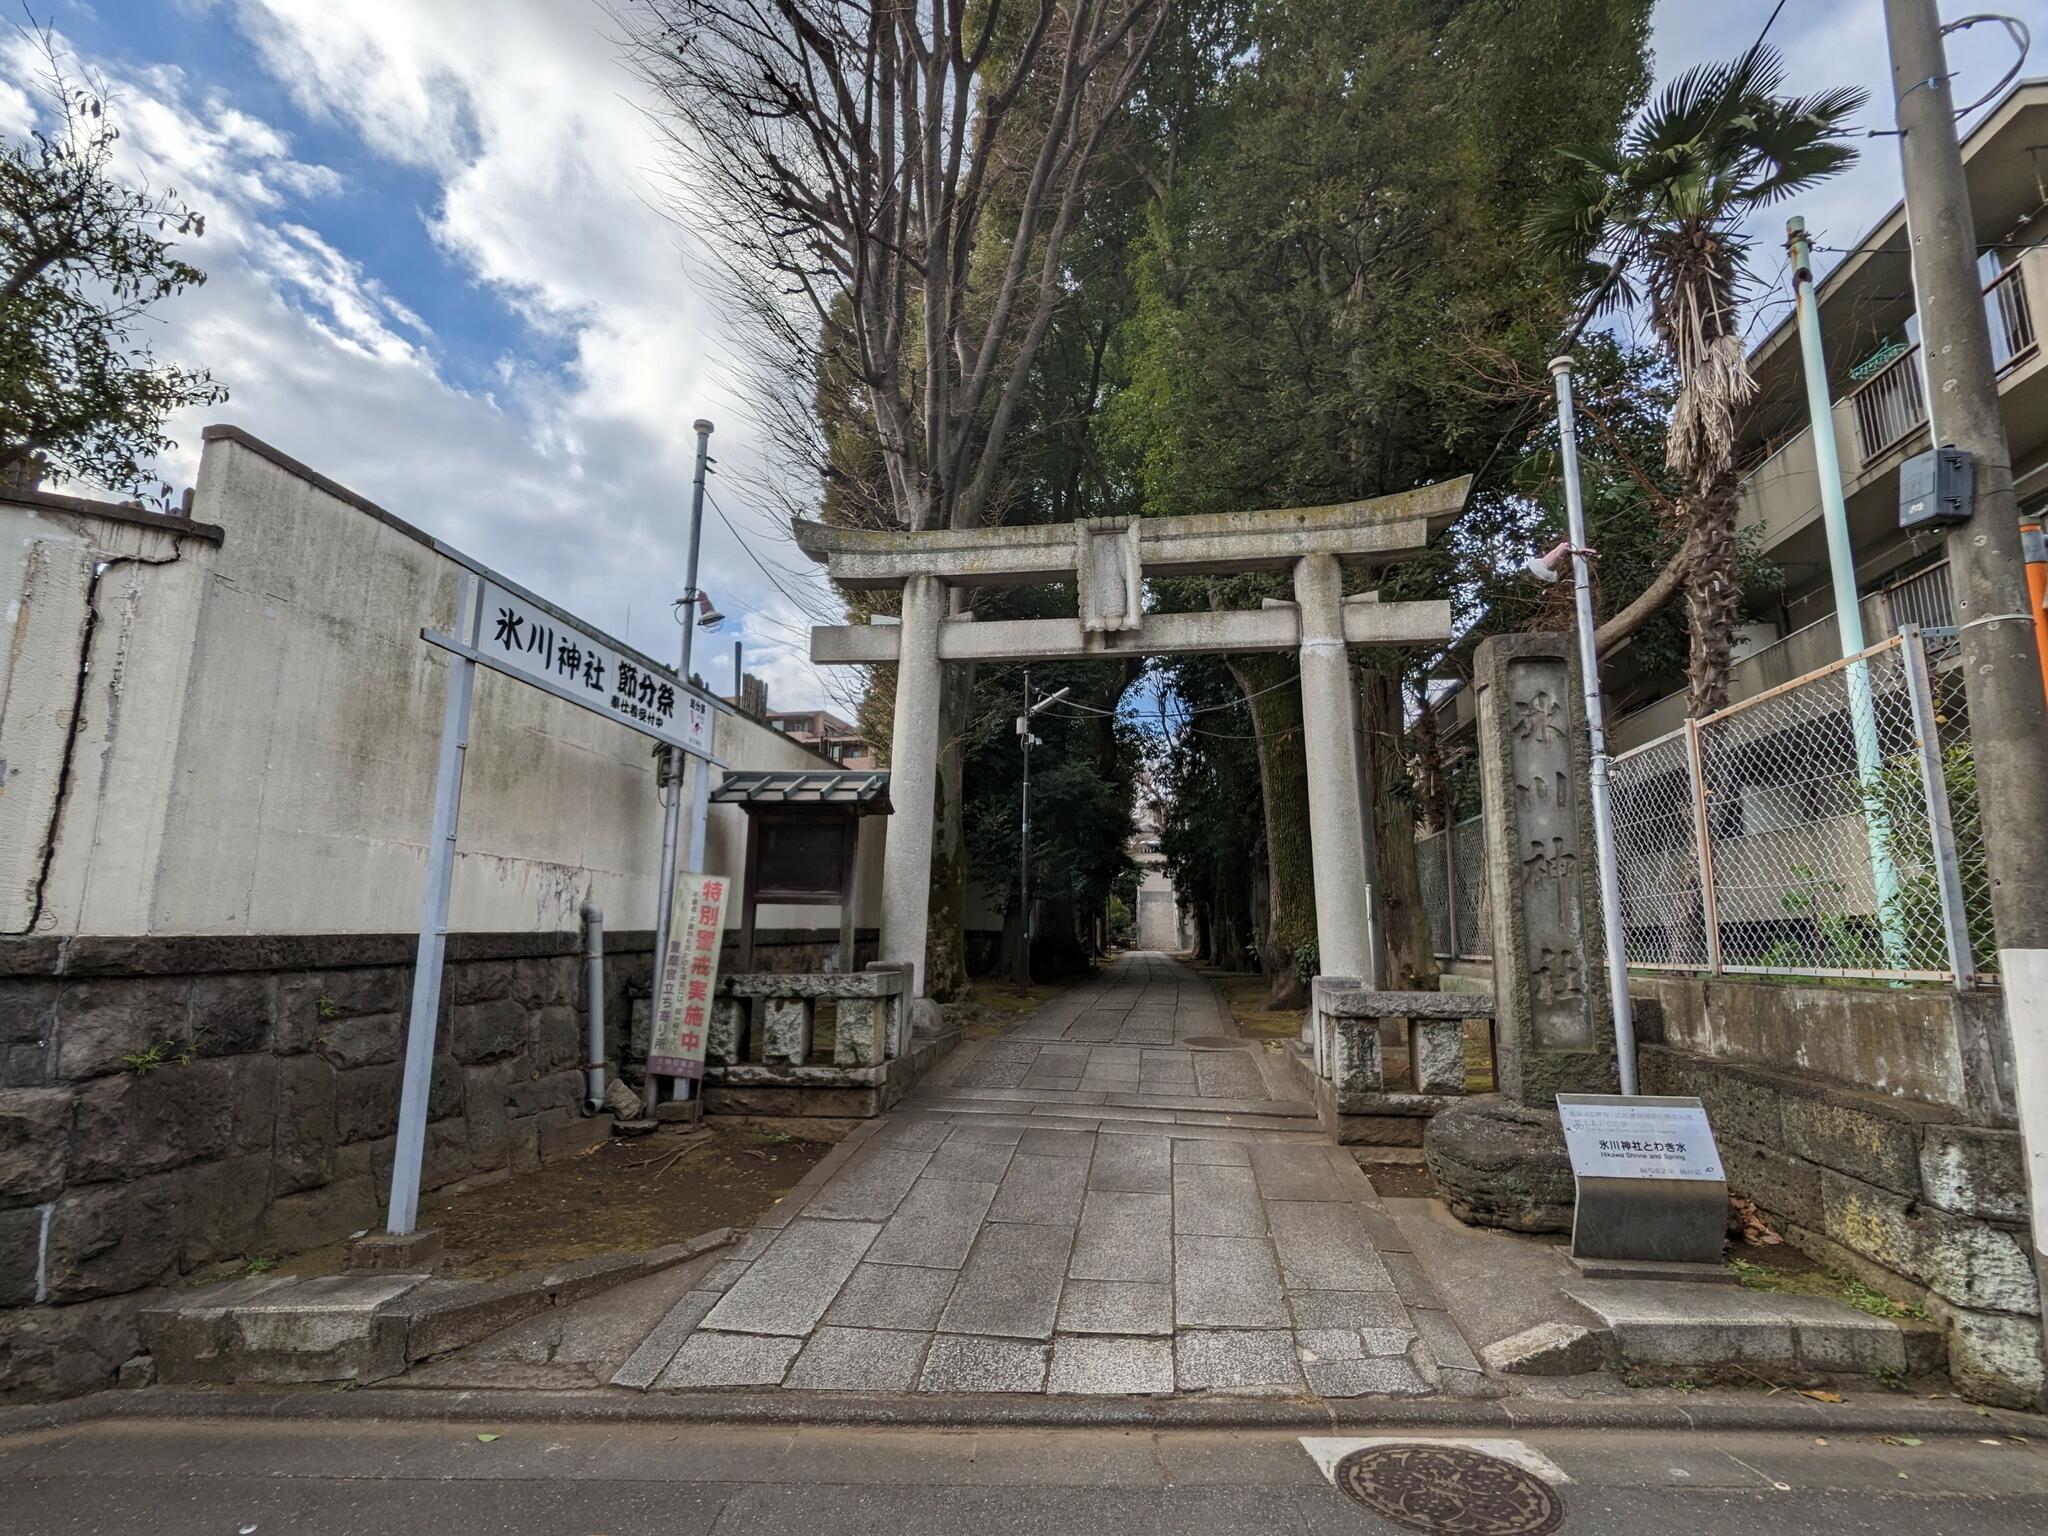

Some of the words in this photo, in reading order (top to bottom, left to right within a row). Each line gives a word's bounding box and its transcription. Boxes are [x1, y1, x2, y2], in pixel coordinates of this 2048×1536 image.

[494, 607, 606, 693] 氷川神社
[617, 659, 675, 719] 節分祭
[1512, 690, 1586, 1006] 氷川神社
[654, 940, 681, 1050] 警察官立ち寄り所
[681, 880, 723, 1052] 特別警戒実施中
[1599, 1140, 1687, 1153] 氷川神社とわき水
